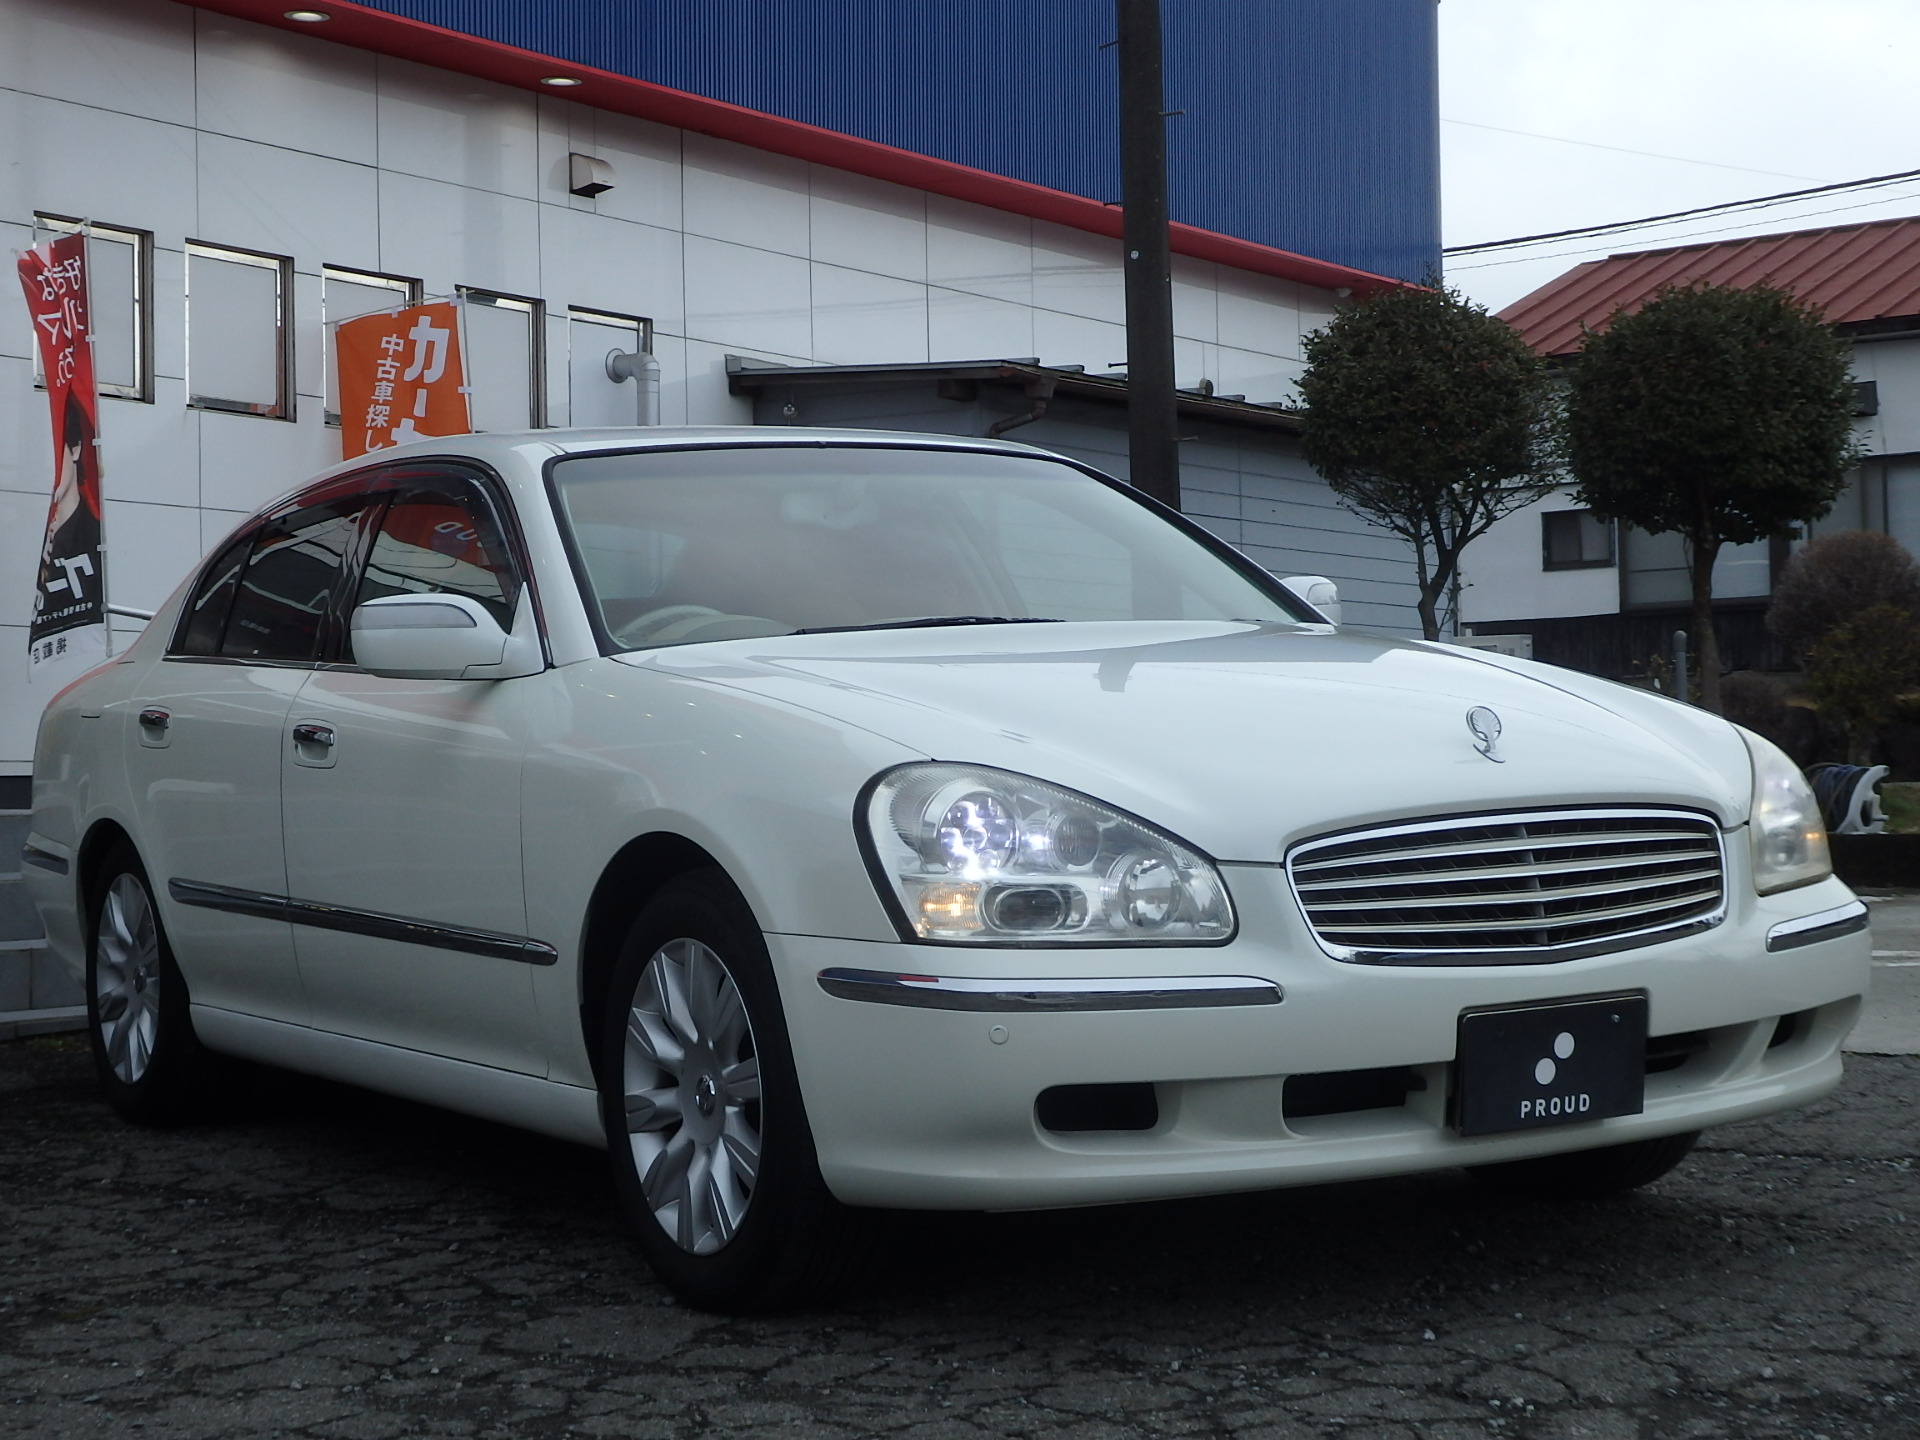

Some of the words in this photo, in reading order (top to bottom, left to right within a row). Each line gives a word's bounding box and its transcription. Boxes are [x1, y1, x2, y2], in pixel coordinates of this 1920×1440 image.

[365, 333, 405, 453] 中古車探し
[1520, 1093, 1590, 1119] PROUD
